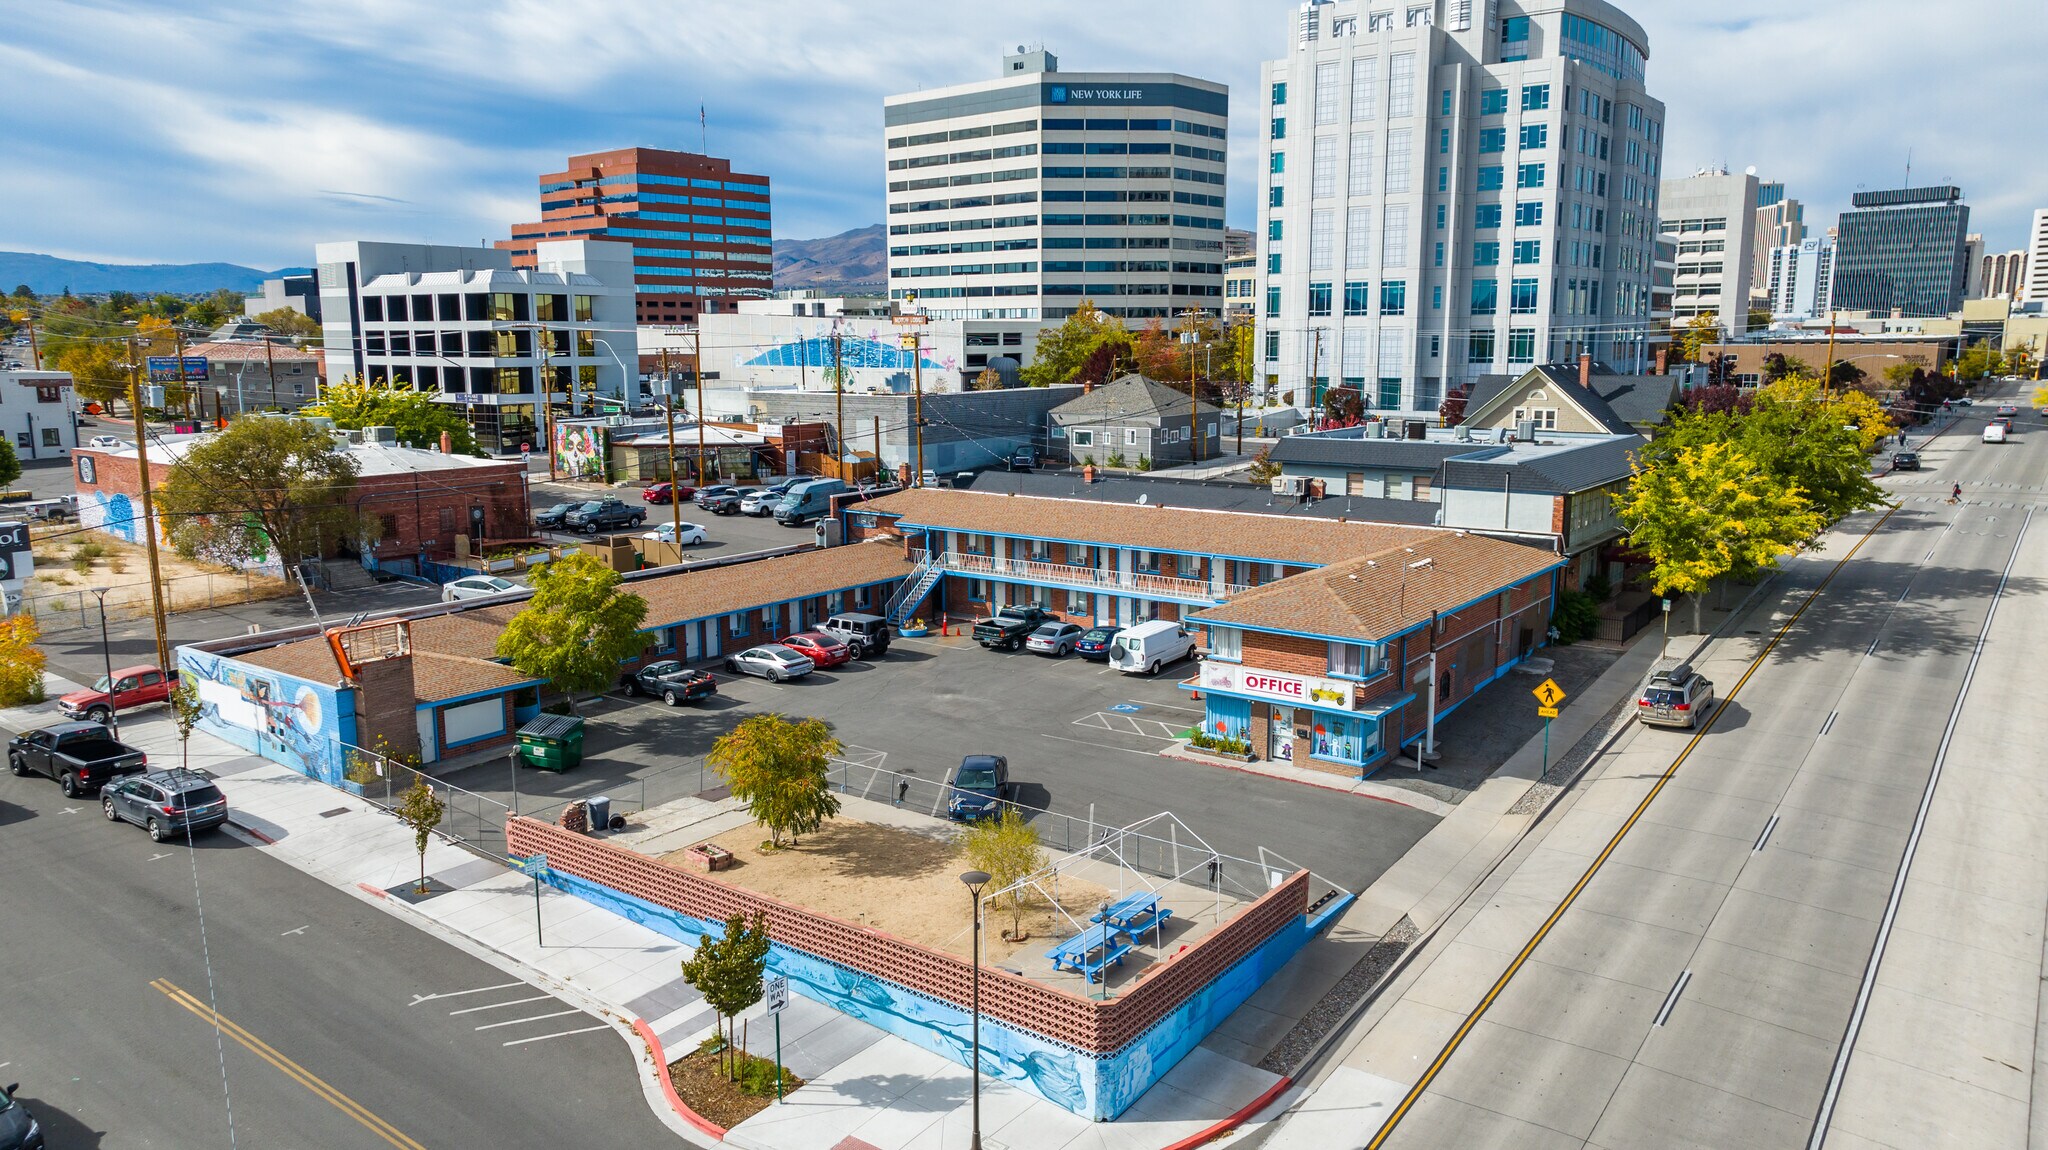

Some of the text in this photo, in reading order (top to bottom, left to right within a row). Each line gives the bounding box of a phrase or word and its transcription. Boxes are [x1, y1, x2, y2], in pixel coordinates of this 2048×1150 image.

[1071, 90, 1094, 99] NEW
[1095, 90, 1121, 99] YORK
[1123, 90, 1142, 99] LIFE
[1246, 675, 1303, 695] OFFICE
[770, 979, 785, 993] ONE
[770, 988, 785, 1002] WAY
